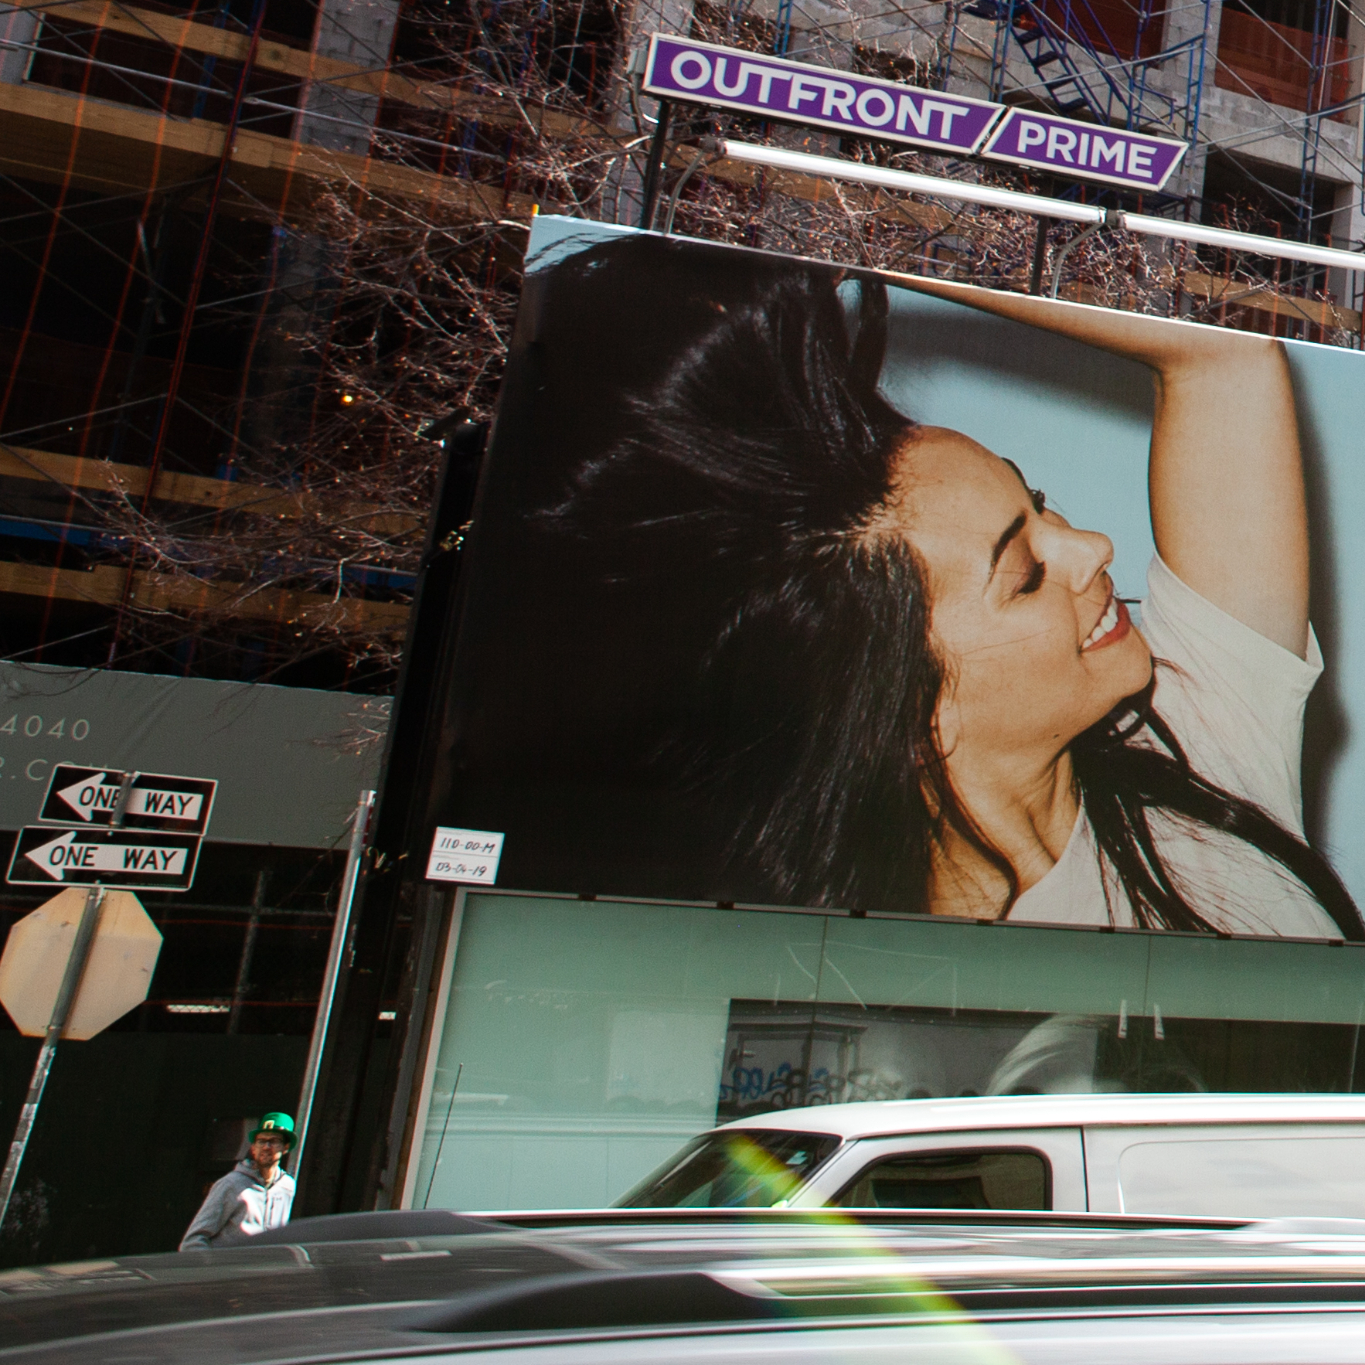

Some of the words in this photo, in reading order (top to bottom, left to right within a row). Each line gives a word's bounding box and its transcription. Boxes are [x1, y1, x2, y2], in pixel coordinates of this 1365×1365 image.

[670, 51, 969, 141] OUTFRONT
[1017, 120, 1158, 179] PRIME
[78, 785, 121, 809] ONE
[144, 791, 194, 816] WAY
[49, 845, 99, 867] ONE
[123, 847, 178, 871] WAY
